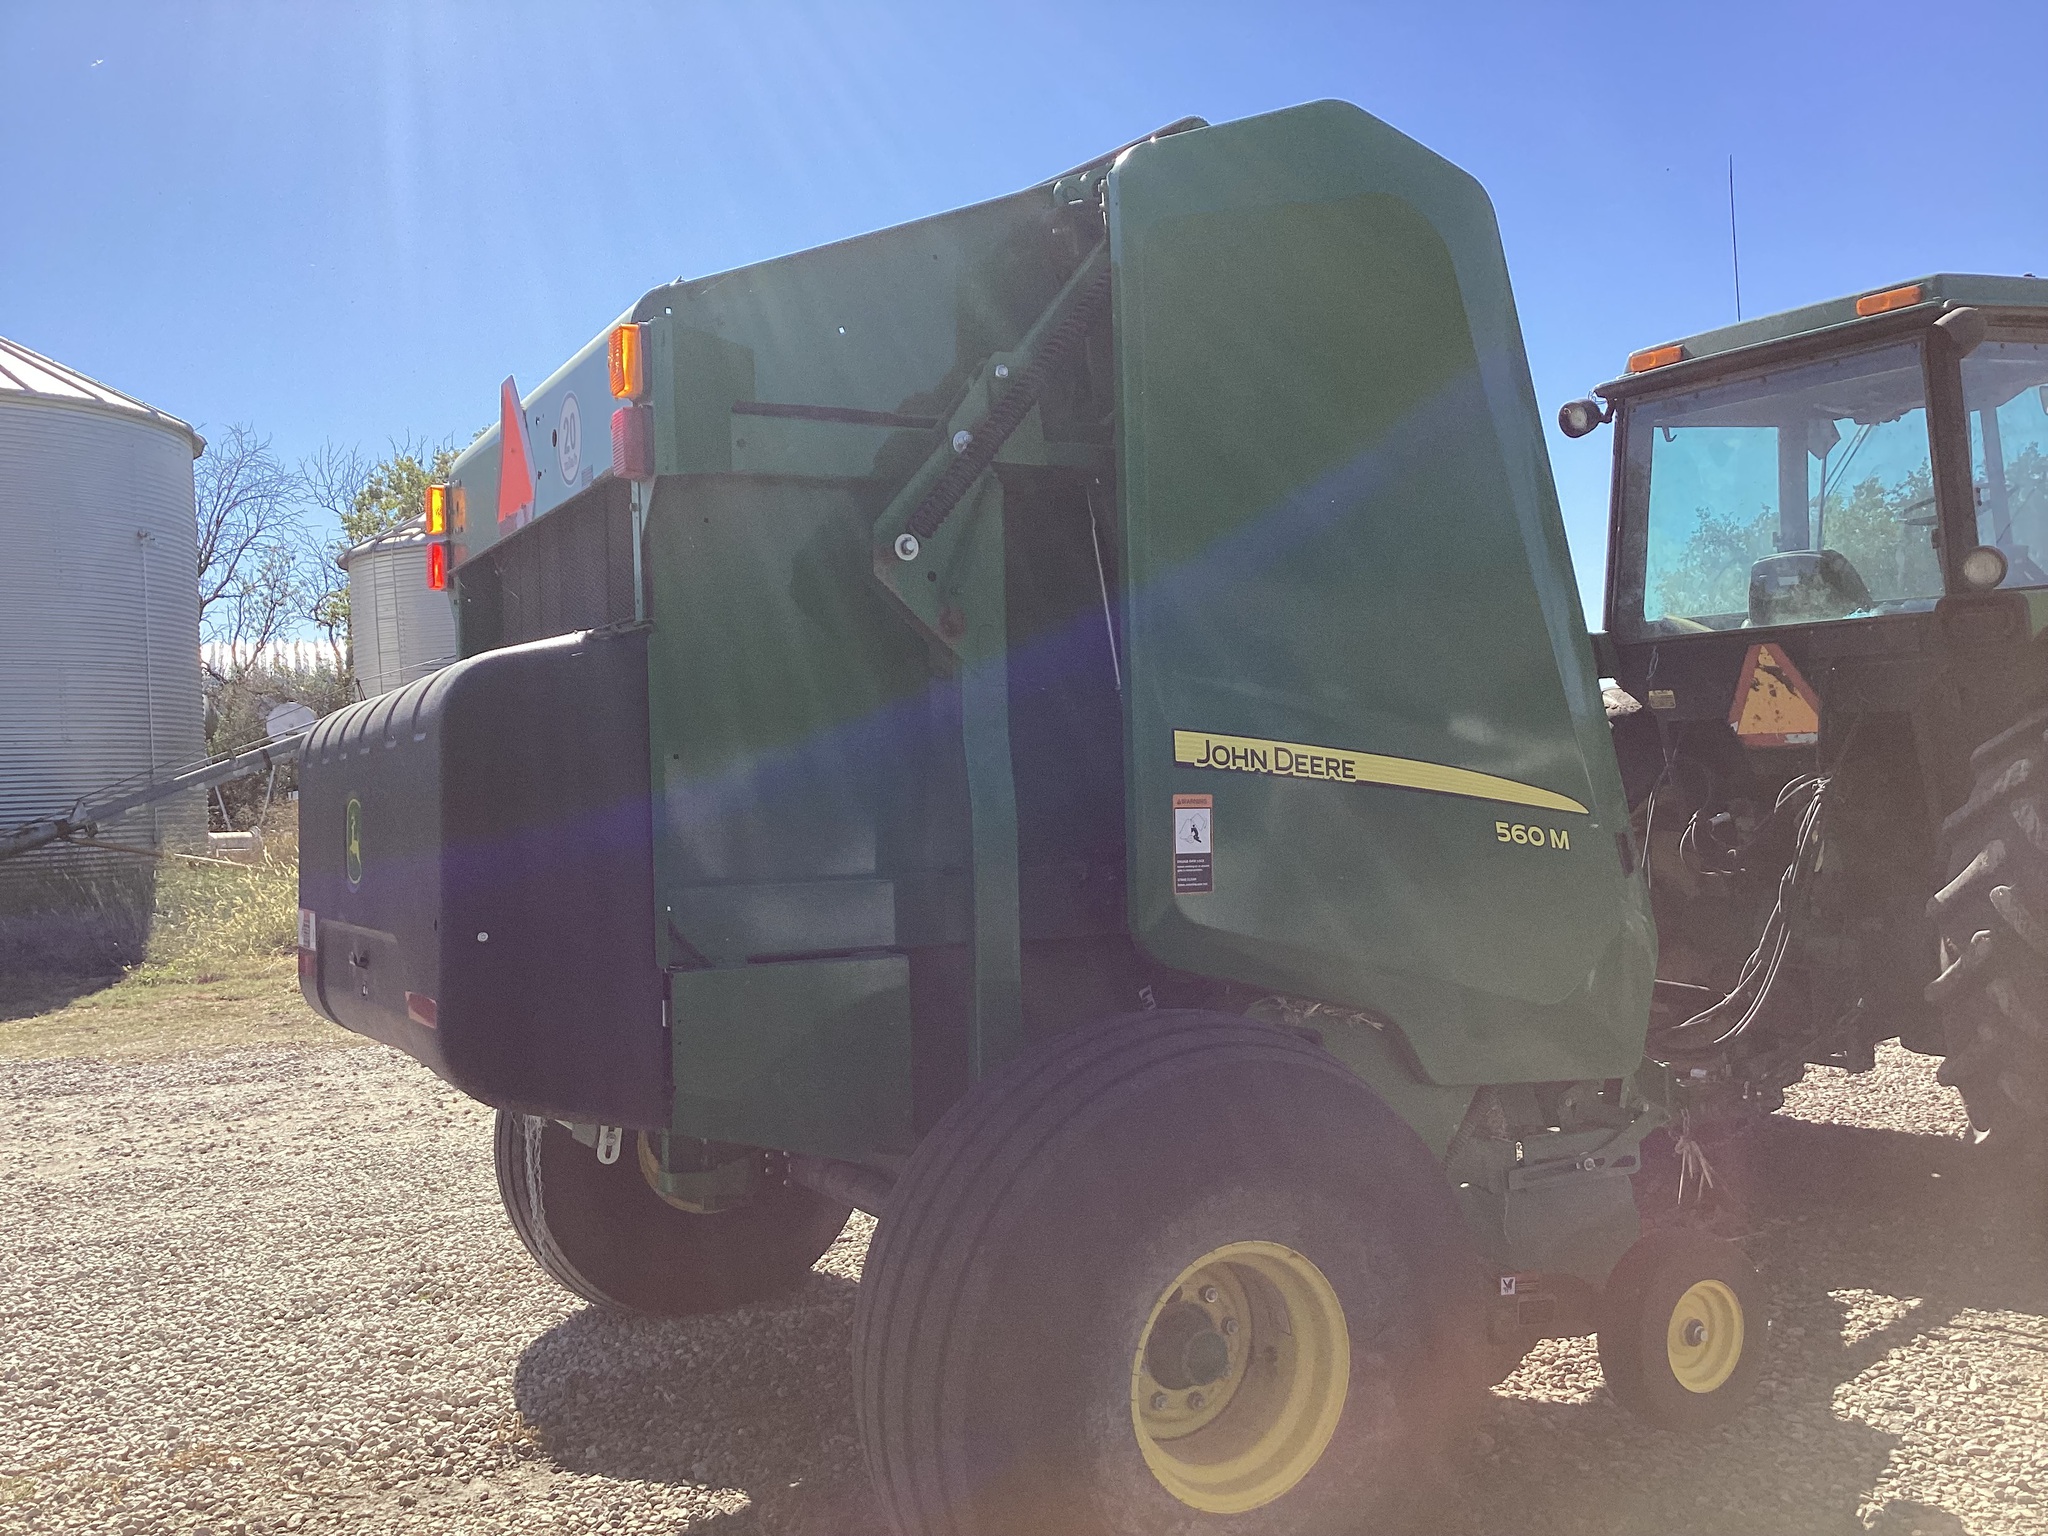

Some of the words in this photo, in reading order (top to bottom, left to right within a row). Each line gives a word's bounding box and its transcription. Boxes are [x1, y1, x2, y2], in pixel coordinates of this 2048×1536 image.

[563, 412, 576, 454] 20
[1197, 740, 1267, 769] JOHN
[1274, 747, 1356, 779] DEERE
[1495, 821, 1546, 847] 560
[1549, 829, 1570, 851] M
